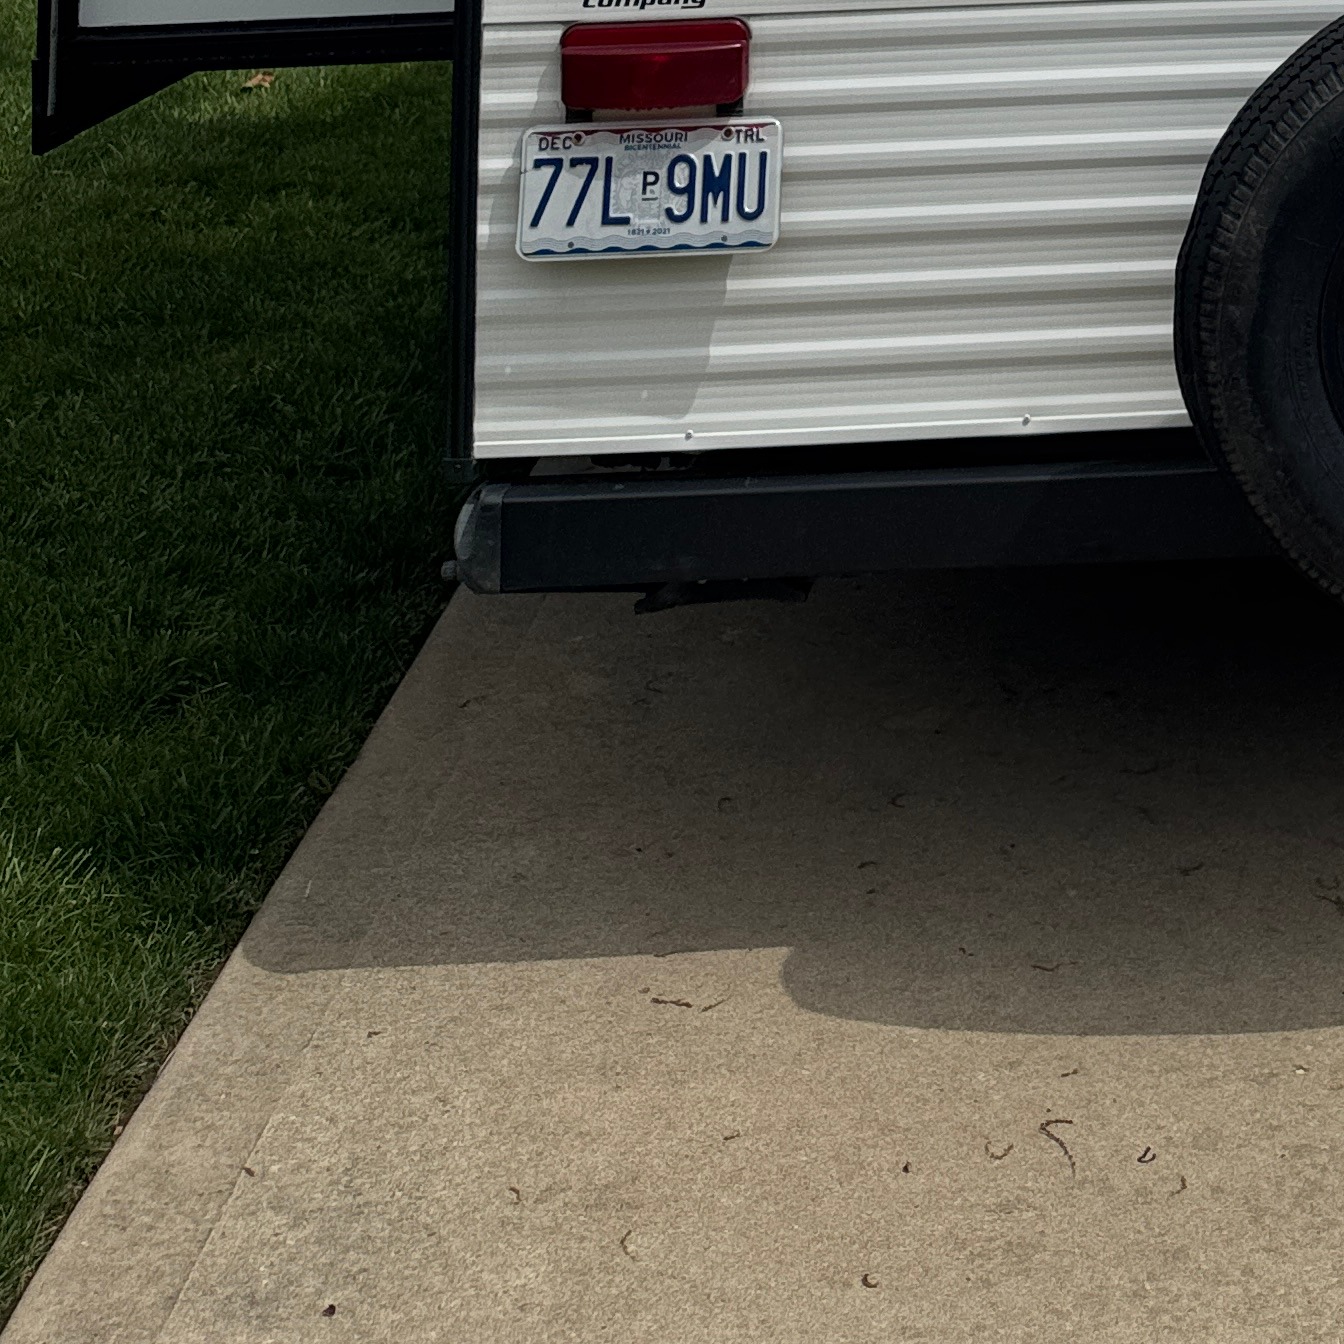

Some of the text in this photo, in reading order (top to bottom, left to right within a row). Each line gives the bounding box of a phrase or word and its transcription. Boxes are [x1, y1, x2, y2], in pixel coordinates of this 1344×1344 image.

[619, 131, 688, 145] MISSOURI
[734, 127, 766, 144] TRL
[538, 136, 572, 152] DEC
[624, 142, 682, 152] BICENTENNIAL
[530, 151, 768, 228] 77L P 9MU
[652, 226, 671, 236] 2021
